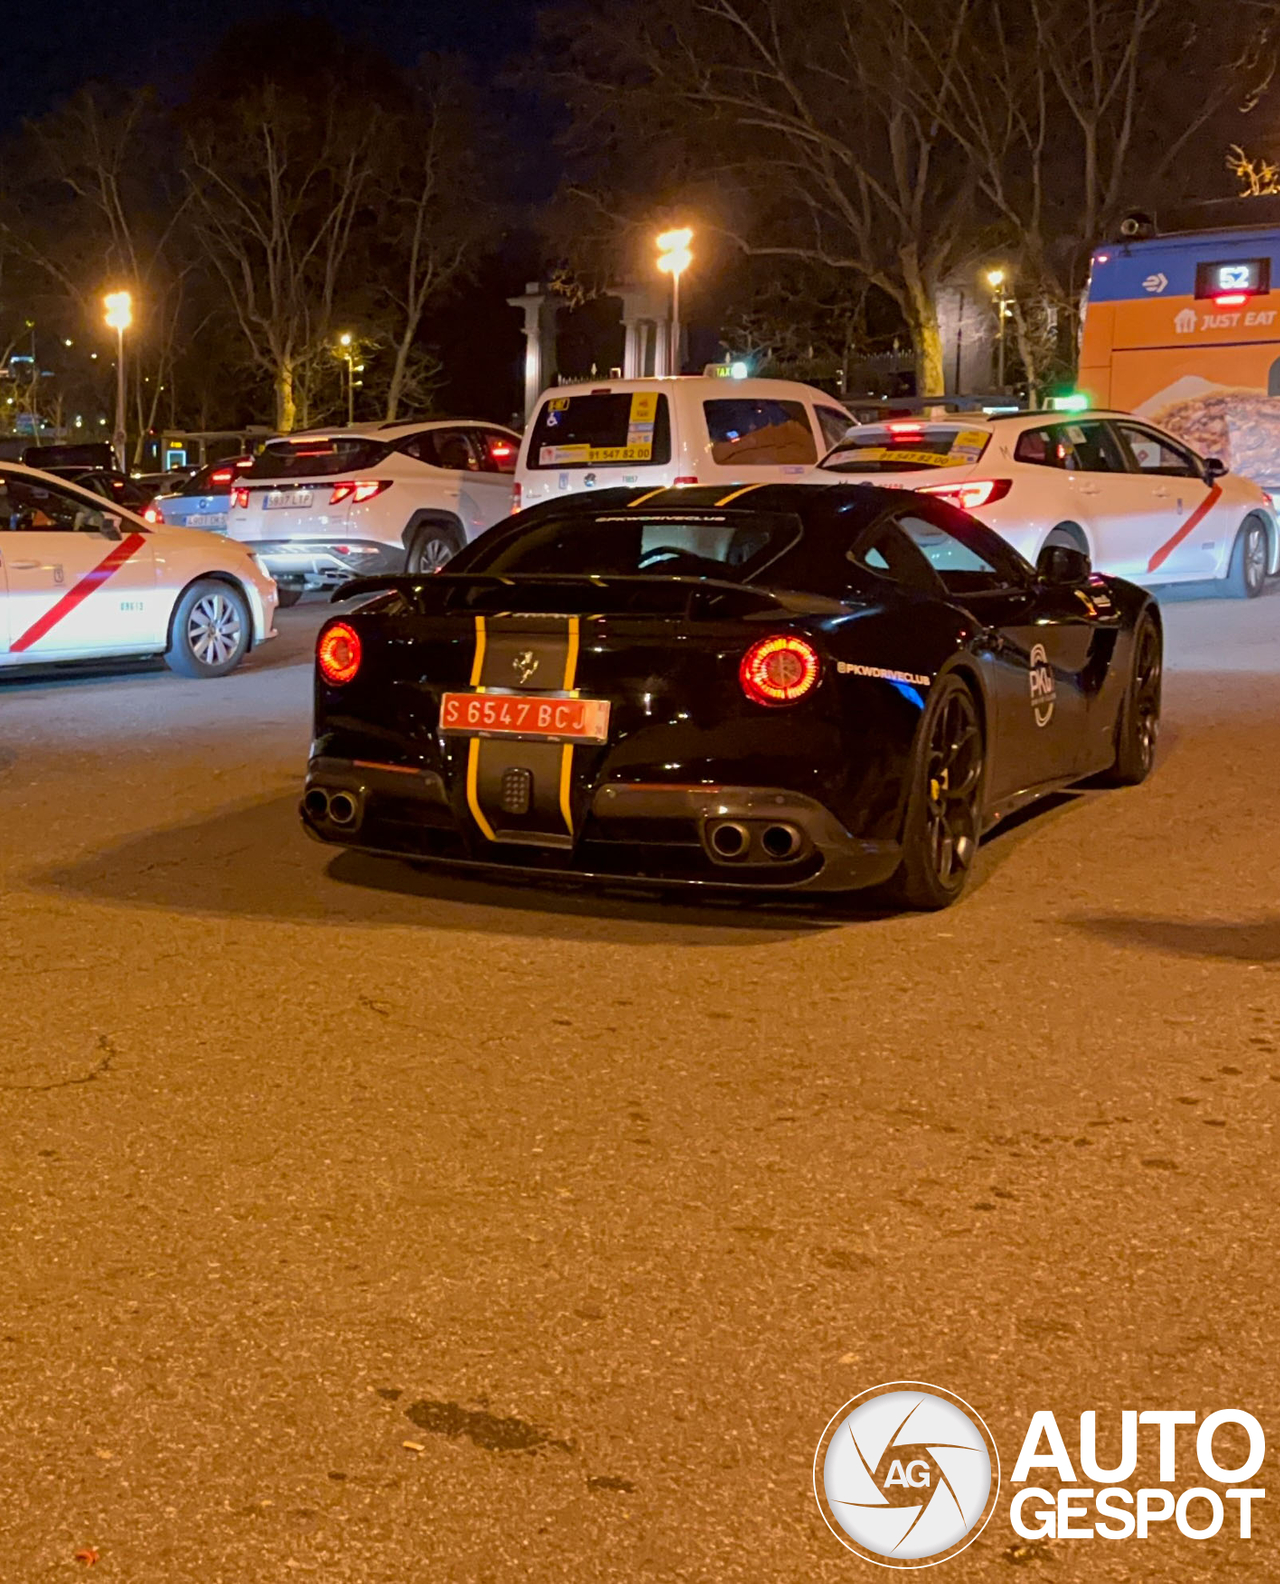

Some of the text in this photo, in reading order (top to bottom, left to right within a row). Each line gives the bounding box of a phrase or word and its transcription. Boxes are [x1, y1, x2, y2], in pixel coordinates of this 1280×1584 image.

[1219, 266, 1249, 290] 52
[1200, 310, 1278, 331] JUST EAT
[603, 450, 620, 459] 547
[622, 449, 635, 459] 82
[637, 448, 650, 458] 00
[837, 661, 931, 686] @PKWDRIVECLUB
[447, 700, 460, 722] S
[467, 700, 531, 727] 6547
[537, 704, 586, 730] BCJ
